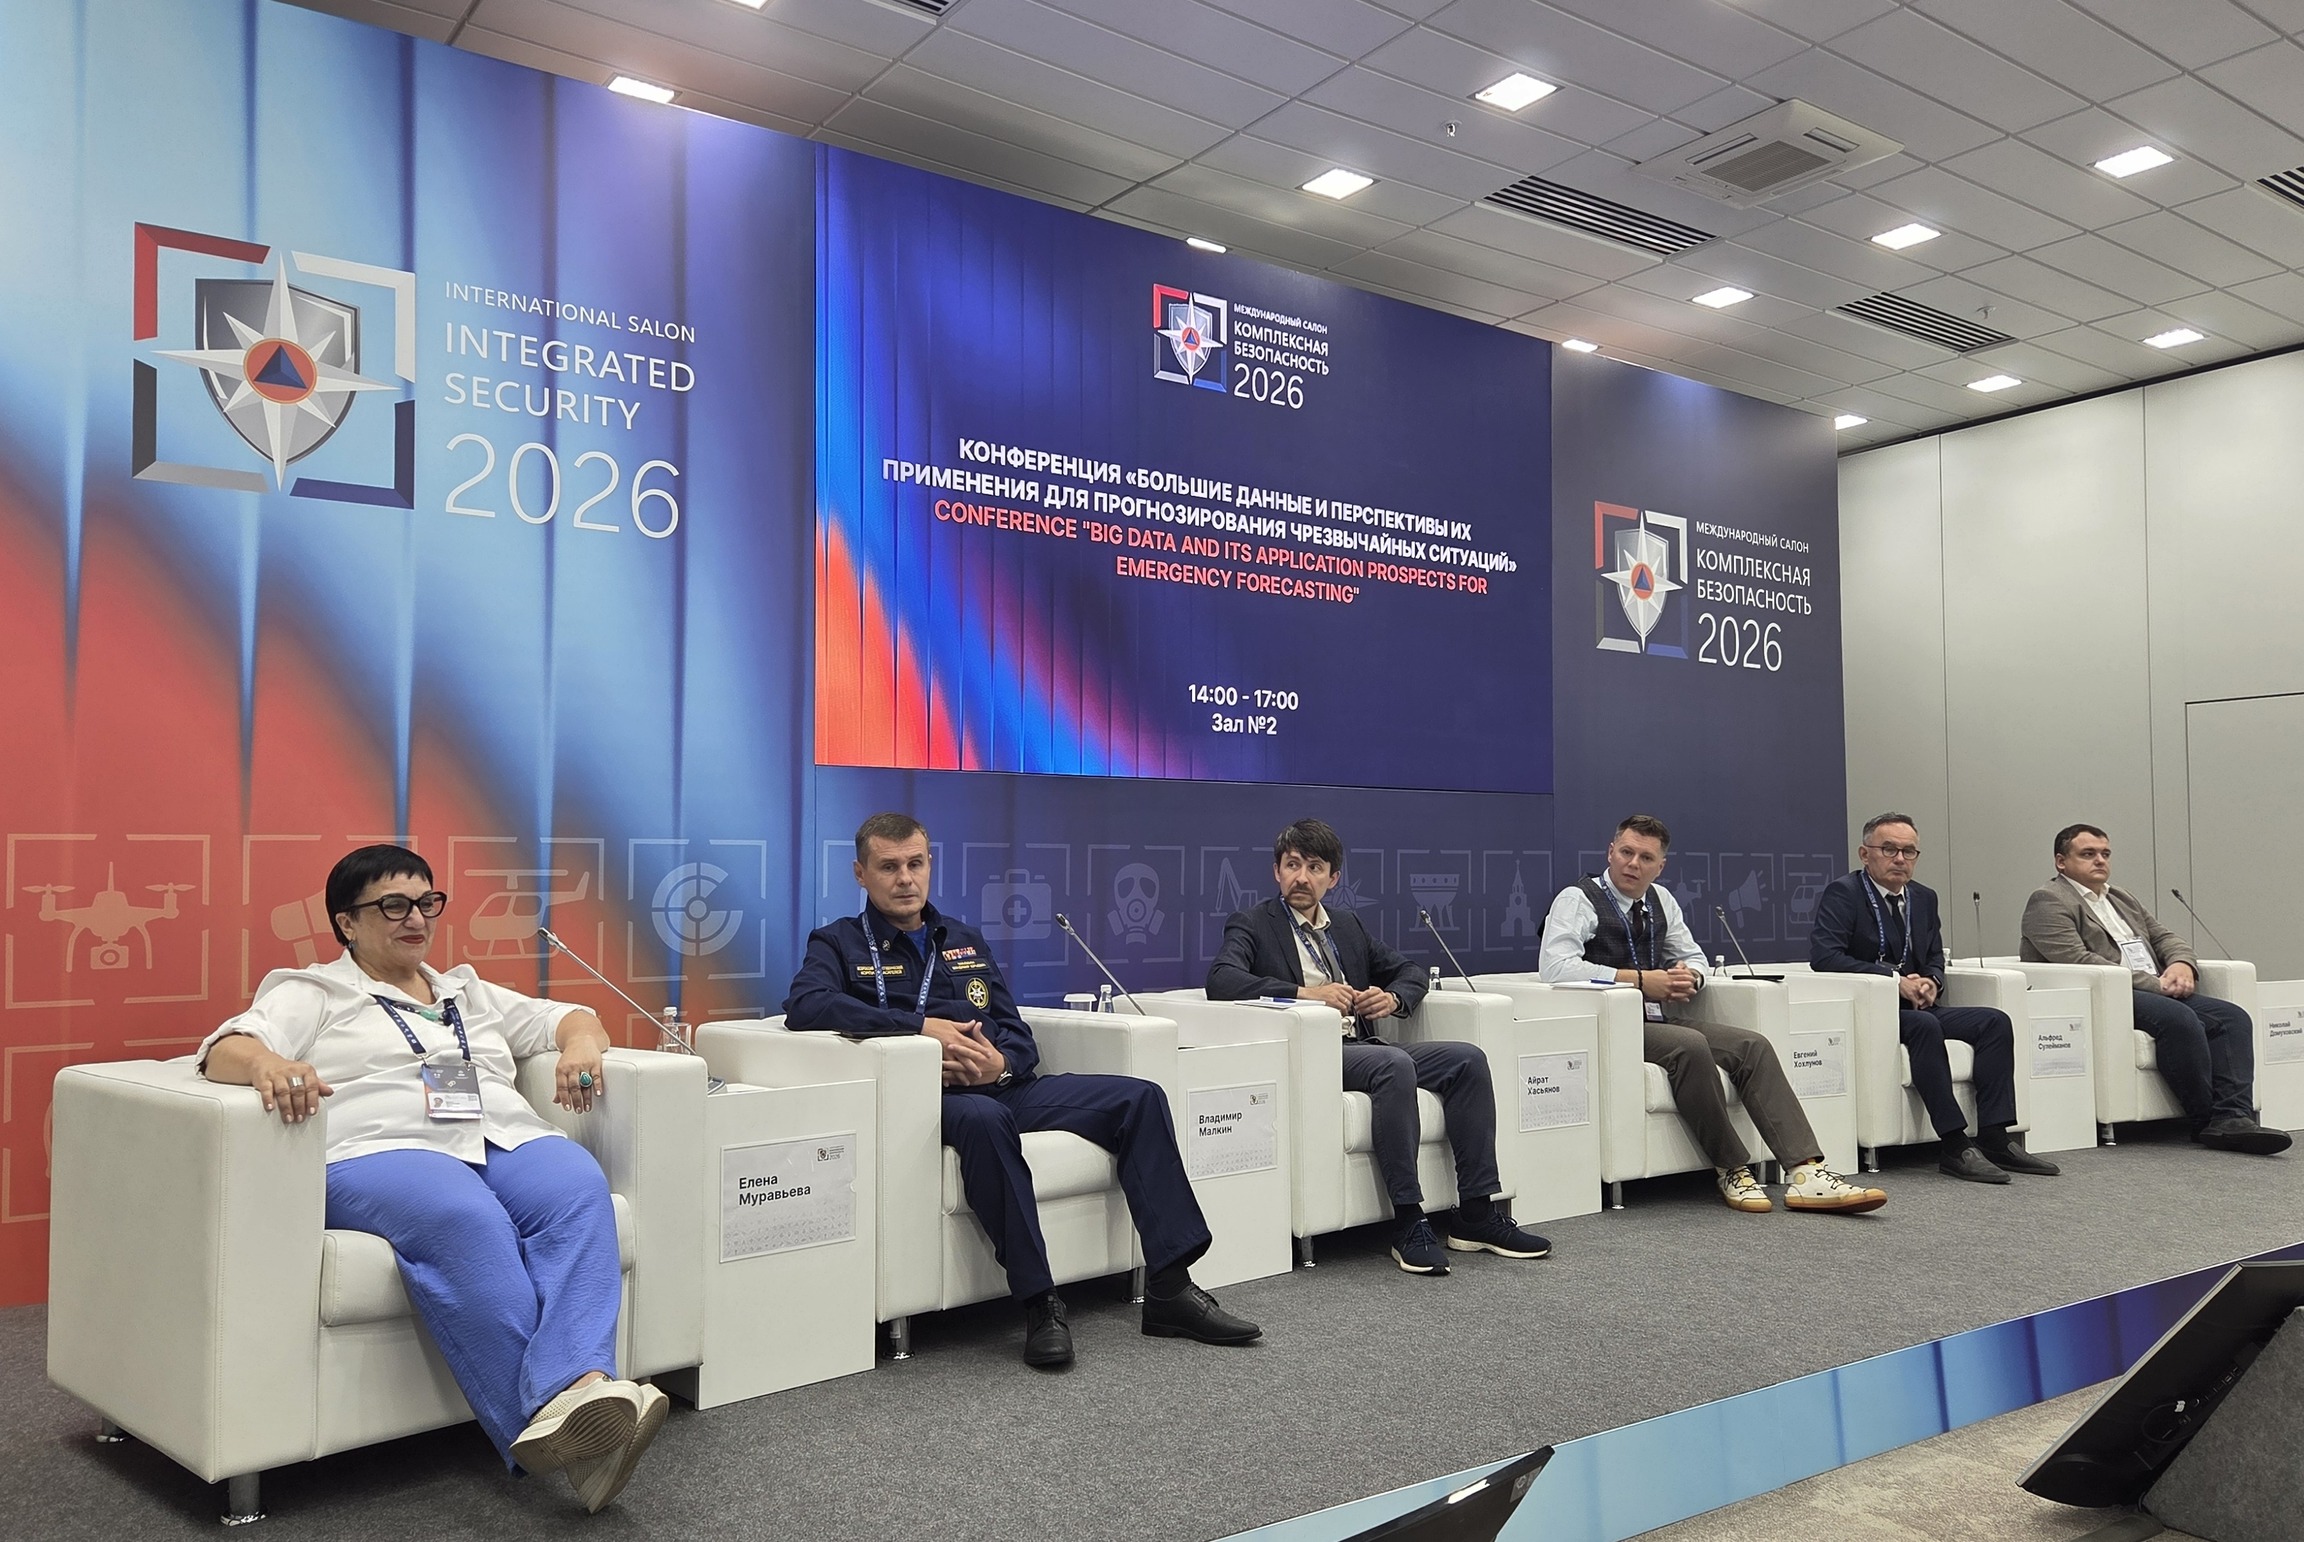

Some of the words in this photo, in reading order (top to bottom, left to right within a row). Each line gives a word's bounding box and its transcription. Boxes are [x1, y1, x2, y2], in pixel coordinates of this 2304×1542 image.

[445, 281, 621, 330] INTERNATIONAL
[628, 315, 696, 343] SALON
[1234, 303, 1301, 328] МЕЖДУНАРОДНЫЙ
[1302, 320, 1328, 334] САЛОН
[1234, 321, 1328, 356] КОМПЛЕКСНАЯ
[445, 321, 695, 392] INTEGRATED
[1234, 341, 1329, 376] БЕЗОПАСНОСТЬ
[444, 372, 640, 430] SECURITY
[1234, 364, 1304, 409] 2026
[445, 433, 680, 539] 2026
[958, 438, 1121, 484] КОНФЕРЕНЦИЯ
[1126, 468, 1232, 502] «БОЛЬШИЕ
[1236, 486, 1312, 515] ДАННЫЕ
[1315, 498, 1328, 518] И
[1330, 501, 1448, 538] ПЕРСПЕКТИВЫ
[1450, 522, 1472, 542] ИХ
[882, 458, 1039, 502] ПРИМЕНЕНИЯ
[1044, 484, 1088, 510] ДЛЯ
[1094, 492, 1286, 539] ПРОГНОЗИРОВАНИЯ
[1290, 522, 1426, 560] ЧРЕЗВЫЧАЙНЫХ
[1428, 543, 1518, 573] СИТУАЦИЙ»
[934, 500, 1078, 539] CONFERENCE
[1082, 520, 1124, 545] "BIG
[1127, 528, 1176, 552] DATA
[1180, 536, 1220, 558] AND
[1224, 540, 1252, 563] ITS
[1255, 546, 1364, 578] APPLICATION
[1367, 560, 1456, 590] PROSPECTS
[1458, 574, 1488, 595] FOR
[1696, 520, 1778, 548] МЕЖДУНАРОДНЫЙ
[1780, 538, 1809, 554] САЛОН
[1116, 556, 1232, 588] EMERGENCY
[1236, 572, 1360, 604] FORECASTING"
[1696, 548, 1811, 587] КОМПЛЕКСНАЯ
[1697, 578, 1812, 616] БЕЗОПАСНОСТЬ
[1698, 612, 1782, 672] 2026
[1188, 684, 1238, 706] 14:00
[1254, 689, 1299, 710] 17:00
[1212, 712, 1244, 733] Зал
[1248, 716, 1277, 735] №2
[2038, 1034, 2062, 1042] Альфред
[2269, 1021, 2290, 1029] Николай
[1794, 1050, 1818, 1059] Евгений
[2038, 1042, 2071, 1051] Сулейманов
[1528, 1076, 1549, 1085] Айрат
[1528, 1086, 1560, 1096] Хасьянов
[1199, 1112, 1242, 1124] Владимир
[1199, 1126, 1232, 1137] Малкин
[739, 1175, 778, 1190] Елена
[739, 1186, 811, 1206] Муравьева
